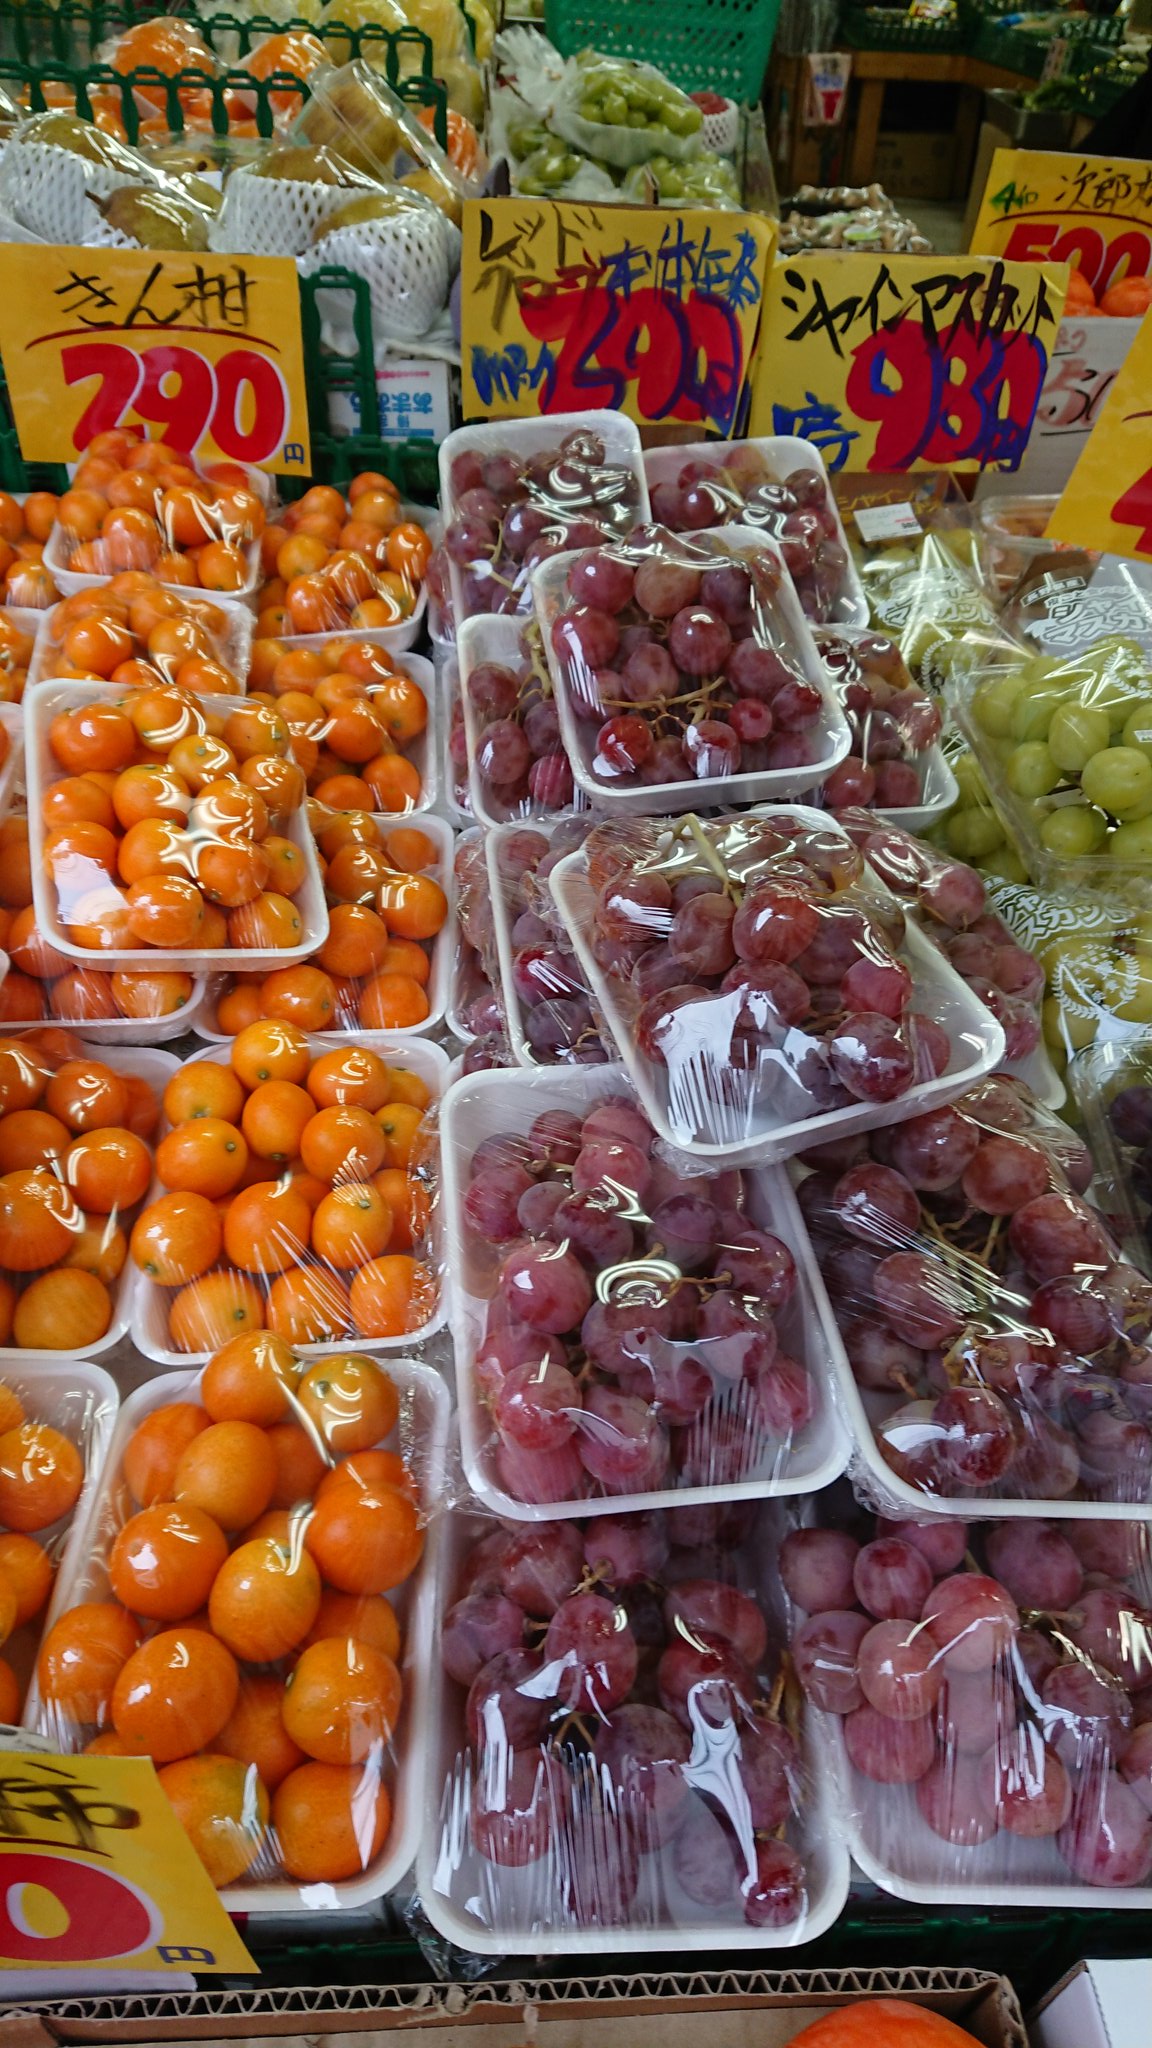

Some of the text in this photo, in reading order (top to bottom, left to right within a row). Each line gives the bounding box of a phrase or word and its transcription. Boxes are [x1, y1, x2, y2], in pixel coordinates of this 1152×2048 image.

[55, 263, 258, 328] きん柑
[782, 261, 1056, 358] シャインマスカット
[61, 343, 291, 463] 290
[846, 319, 1049, 473] 980
[284, 443, 306, 464] 円
